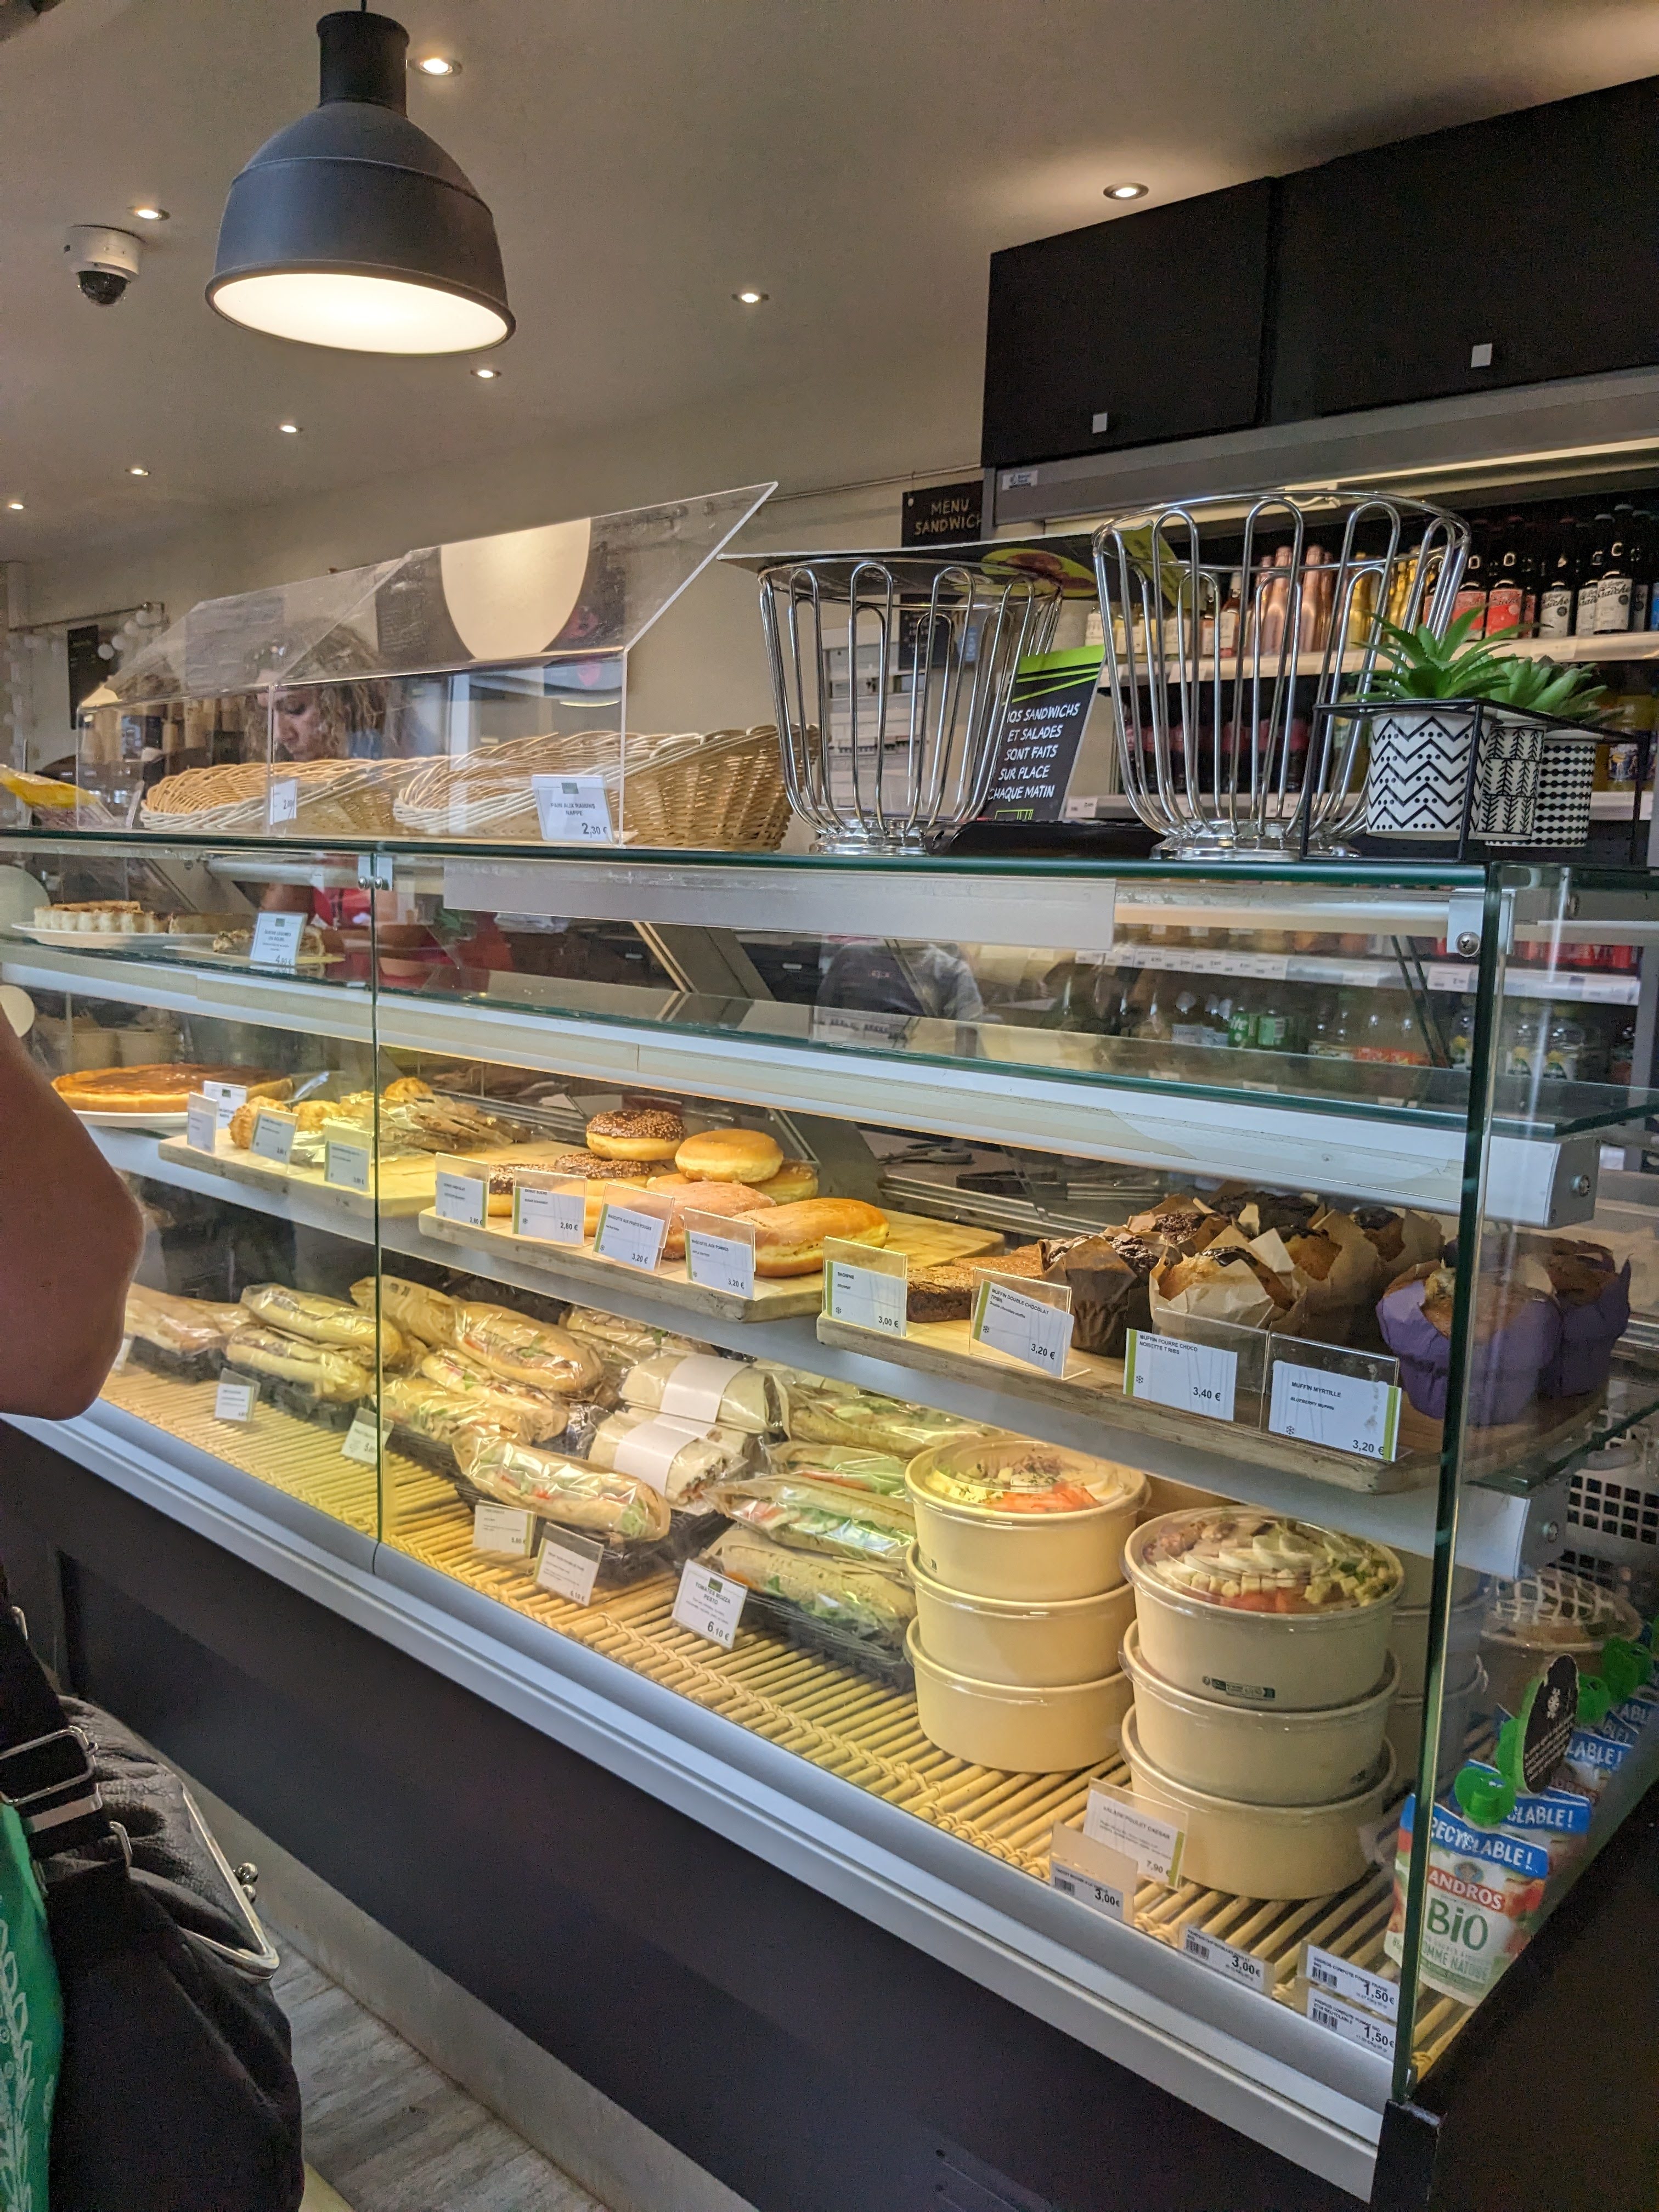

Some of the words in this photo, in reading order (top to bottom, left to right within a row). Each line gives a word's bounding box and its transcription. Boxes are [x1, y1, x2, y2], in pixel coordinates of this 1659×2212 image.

[931, 497, 969, 516] MENU
[1023, 703, 1081, 722] SANDWICHS
[1007, 729, 1019, 742] ET
[1020, 724, 1064, 741] SALADES
[1004, 747, 1030, 761] SONT
[1031, 744, 1059, 760] FAITS
[998, 768, 1016, 781] SUR
[1017, 765, 1051, 780] PLACE
[988, 787, 1024, 803] CHAQUE
[1025, 785, 1056, 799] MATIN
[582, 822, 601, 838] 2,30
[561, 1222, 573, 1231] 2,80
[632, 1253, 643, 1263] 3,20
[728, 1278, 740, 1288] 3,20
[740, 1282, 744, 1290] €
[992, 1289, 1007, 1298] MUFFIN
[1007, 1295, 1024, 1306] DOUBLE
[1025, 1302, 1049, 1315] CHOCOLAT
[878, 1316, 892, 1326] 3,00
[1139, 1341, 1163, 1351] NOISETTE
[1140, 1334, 1157, 1342] MUFFIN
[1158, 1339, 1178, 1347] FOURRE
[1180, 1344, 1198, 1352] CHOCO
[1031, 1344, 1048, 1357] 3,20
[1049, 1351, 1056, 1360] €
[1193, 1386, 1212, 1400] 3,40
[1215, 1392, 1221, 1402] €
[1291, 1381, 1312, 1391] MUFFIN
[1313, 1386, 1341, 1398] MYRTILLE
[1290, 1396, 1317, 1407] BLUEBERRY
[1318, 1402, 1334, 1410] MUFFIN
[1352, 1440, 1374, 1453] 3,20
[1378, 1446, 1385, 1455] €
[696, 1582, 715, 1596] TOMATES
[703, 1594, 718, 1605] PESTO
[1507, 1805, 1574, 1829] CLABLE!
[1125, 1815, 1146, 1829] POULET
[1147, 1824, 1171, 1840] CAESAR
[1147, 1860, 1163, 1874] 7,90
[1428, 1869, 1503, 1911] ANDROS
[1423, 1941, 1449, 1966] OMME
